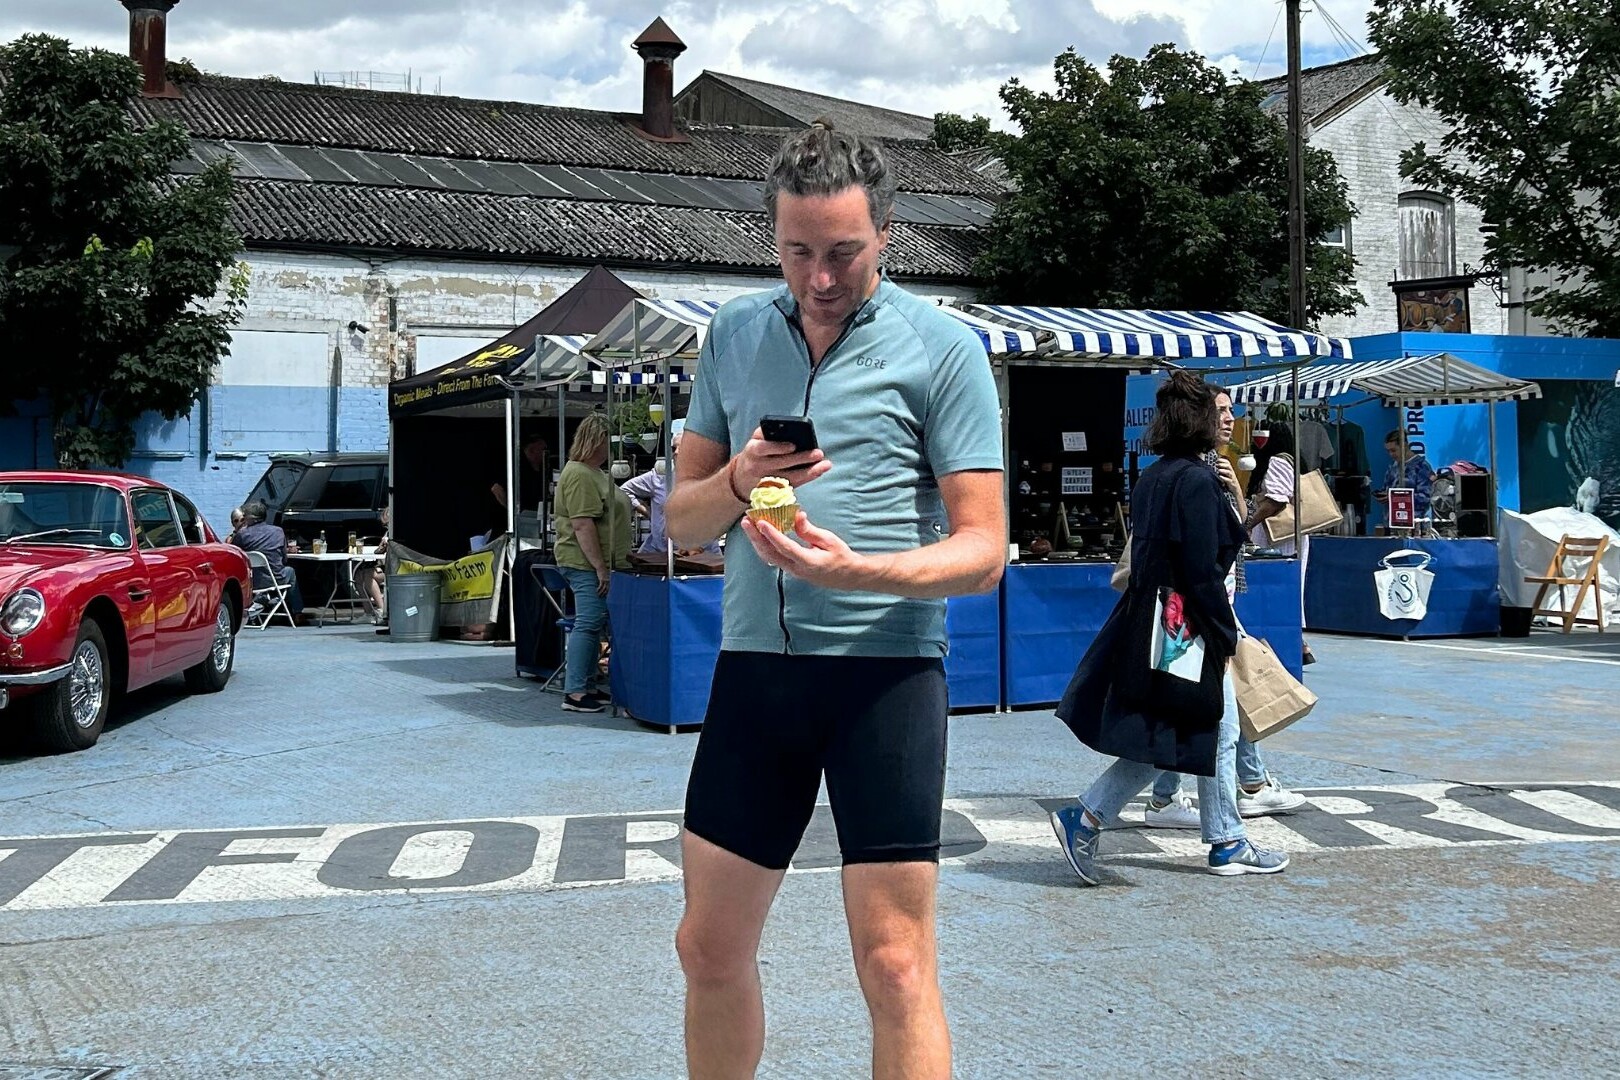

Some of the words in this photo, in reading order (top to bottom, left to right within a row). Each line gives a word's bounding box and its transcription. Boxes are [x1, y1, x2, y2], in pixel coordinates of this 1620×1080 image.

[857, 357, 887, 369] GORE
[394, 391, 414, 407] Organic
[437, 380, 455, 394] Direct
[455, 379, 470, 391] From
[472, 376, 482, 388] The
[483, 374, 500, 387] Far
[1124, 407, 1158, 428] ALLER
[1406, 403, 1426, 436] PR
[454, 560, 486, 580] Farm
